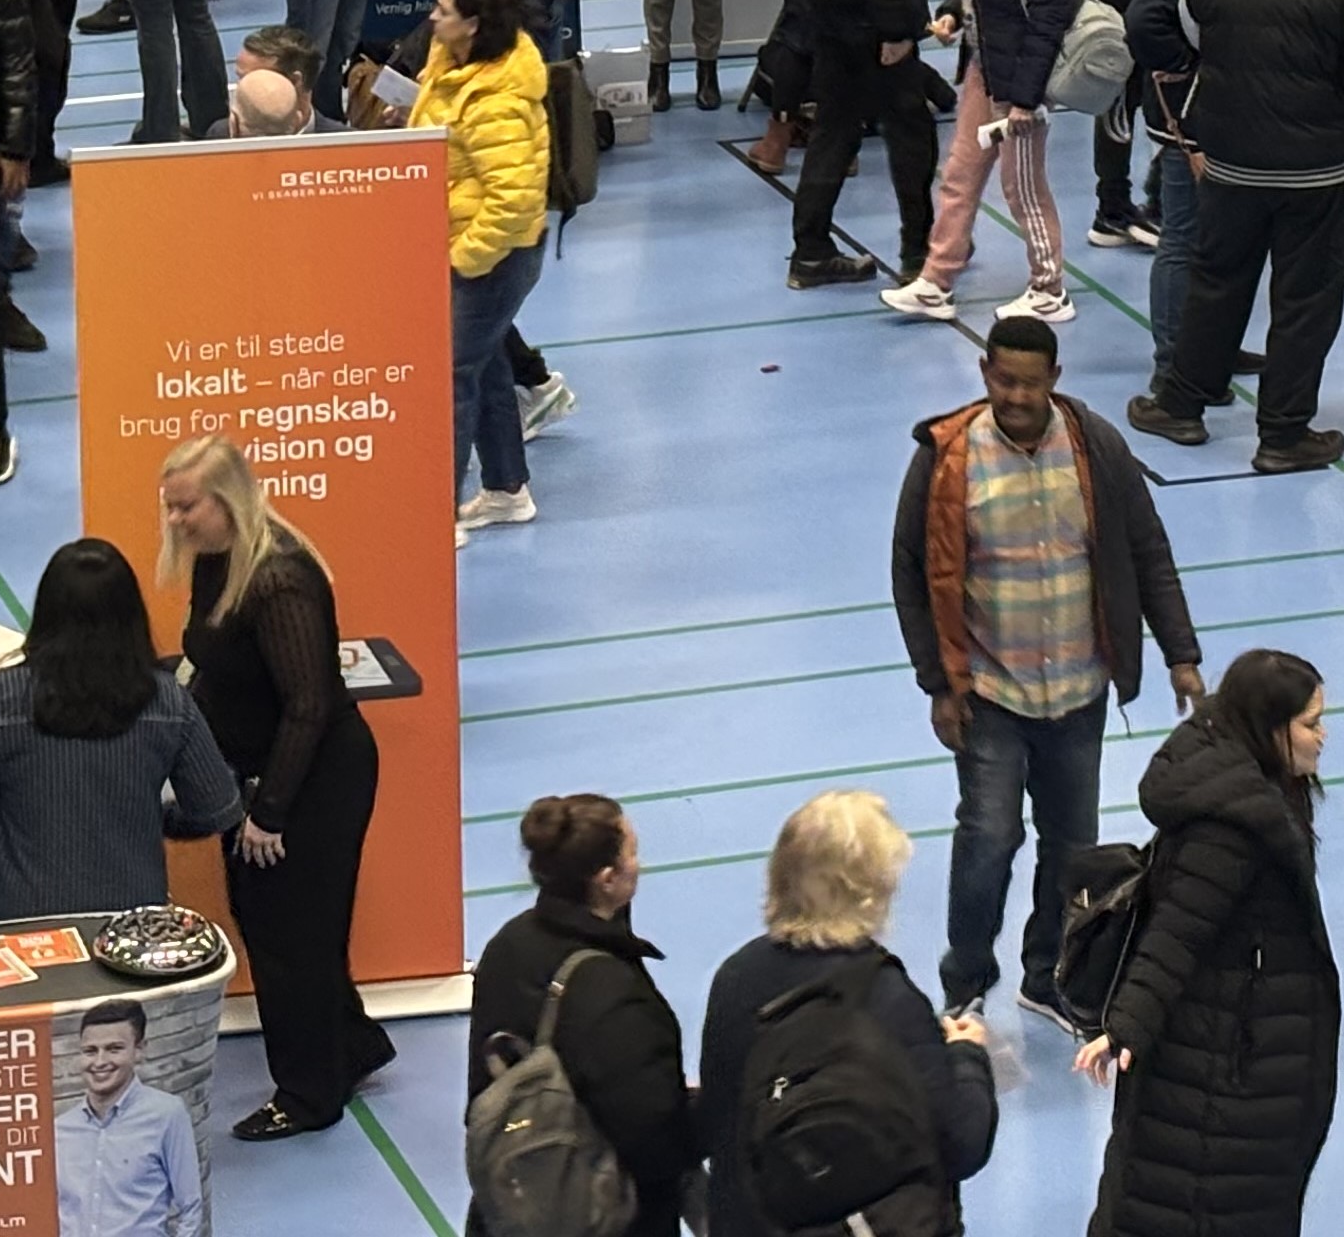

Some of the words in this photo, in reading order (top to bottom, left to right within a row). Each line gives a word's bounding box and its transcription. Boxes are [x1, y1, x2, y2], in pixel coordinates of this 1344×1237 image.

[280, 164, 429, 187] BEIERHOLM
[268, 188, 316, 200] SKABER
[319, 184, 373, 197] BALANCE
[165, 338, 192, 363] Vi
[198, 343, 229, 362] er
[235, 335, 262, 359] til
[268, 328, 346, 357] stede
[156, 367, 248, 400] lokalt
[280, 367, 326, 392] når
[332, 362, 377, 388] der
[383, 362, 415, 383] er
[119, 414, 182, 440] brug
[189, 408, 232, 433] for
[239, 391, 397, 433] regnskab,
[333, 433, 374, 462] og
[6, 1125, 42, 1146] DIT
